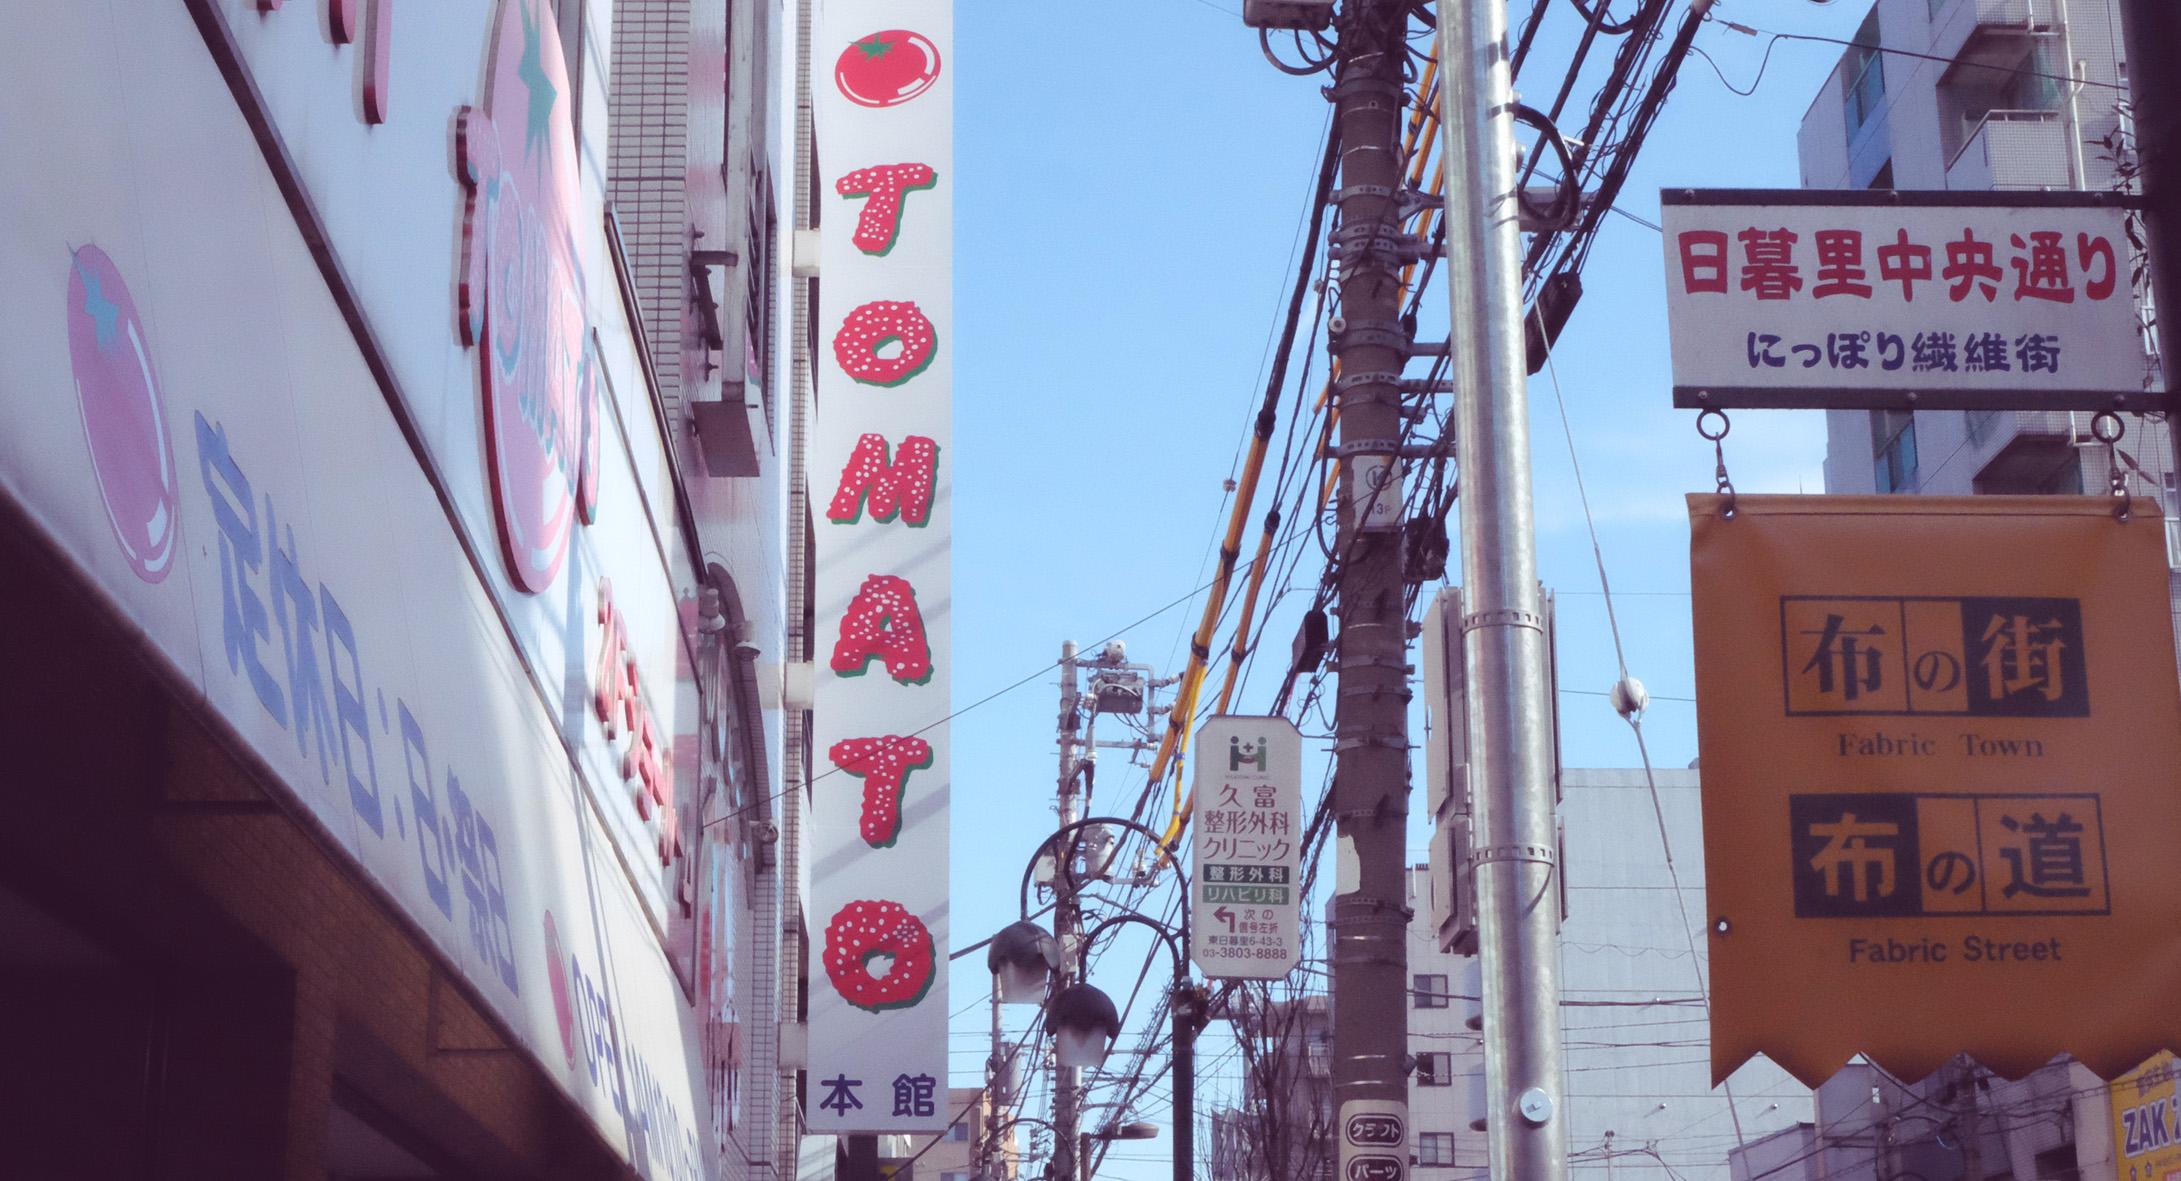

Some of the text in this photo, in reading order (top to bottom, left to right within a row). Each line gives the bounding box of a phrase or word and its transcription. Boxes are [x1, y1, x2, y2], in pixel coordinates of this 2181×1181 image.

[1678, 226, 2117, 304] 日暮里中央通り
[1747, 331, 2061, 374] にっぽり繊維街
[823, 163, 941, 1013] TOMATO
[1800, 614, 2066, 701] 布の街
[1838, 733, 2044, 757] Fabric Town
[1218, 783, 1276, 808] 久富
[1204, 810, 1289, 836] 整形外科
[1203, 837, 1290, 861] クリニック
[1809, 812, 2092, 903] 布の道
[1209, 866, 1284, 882] 整形外科
[1208, 887, 1284, 903] リハビリ科
[1202, 947, 1288, 959] 03-3803-8888
[1849, 936, 2062, 963] Fabric Street
[819, 1073, 936, 1118] 本館
[1352, 1122, 1399, 1138] クラフト
[2123, 1099, 2170, 1156] ZAK
[1354, 1163, 1397, 1180] パーツ
